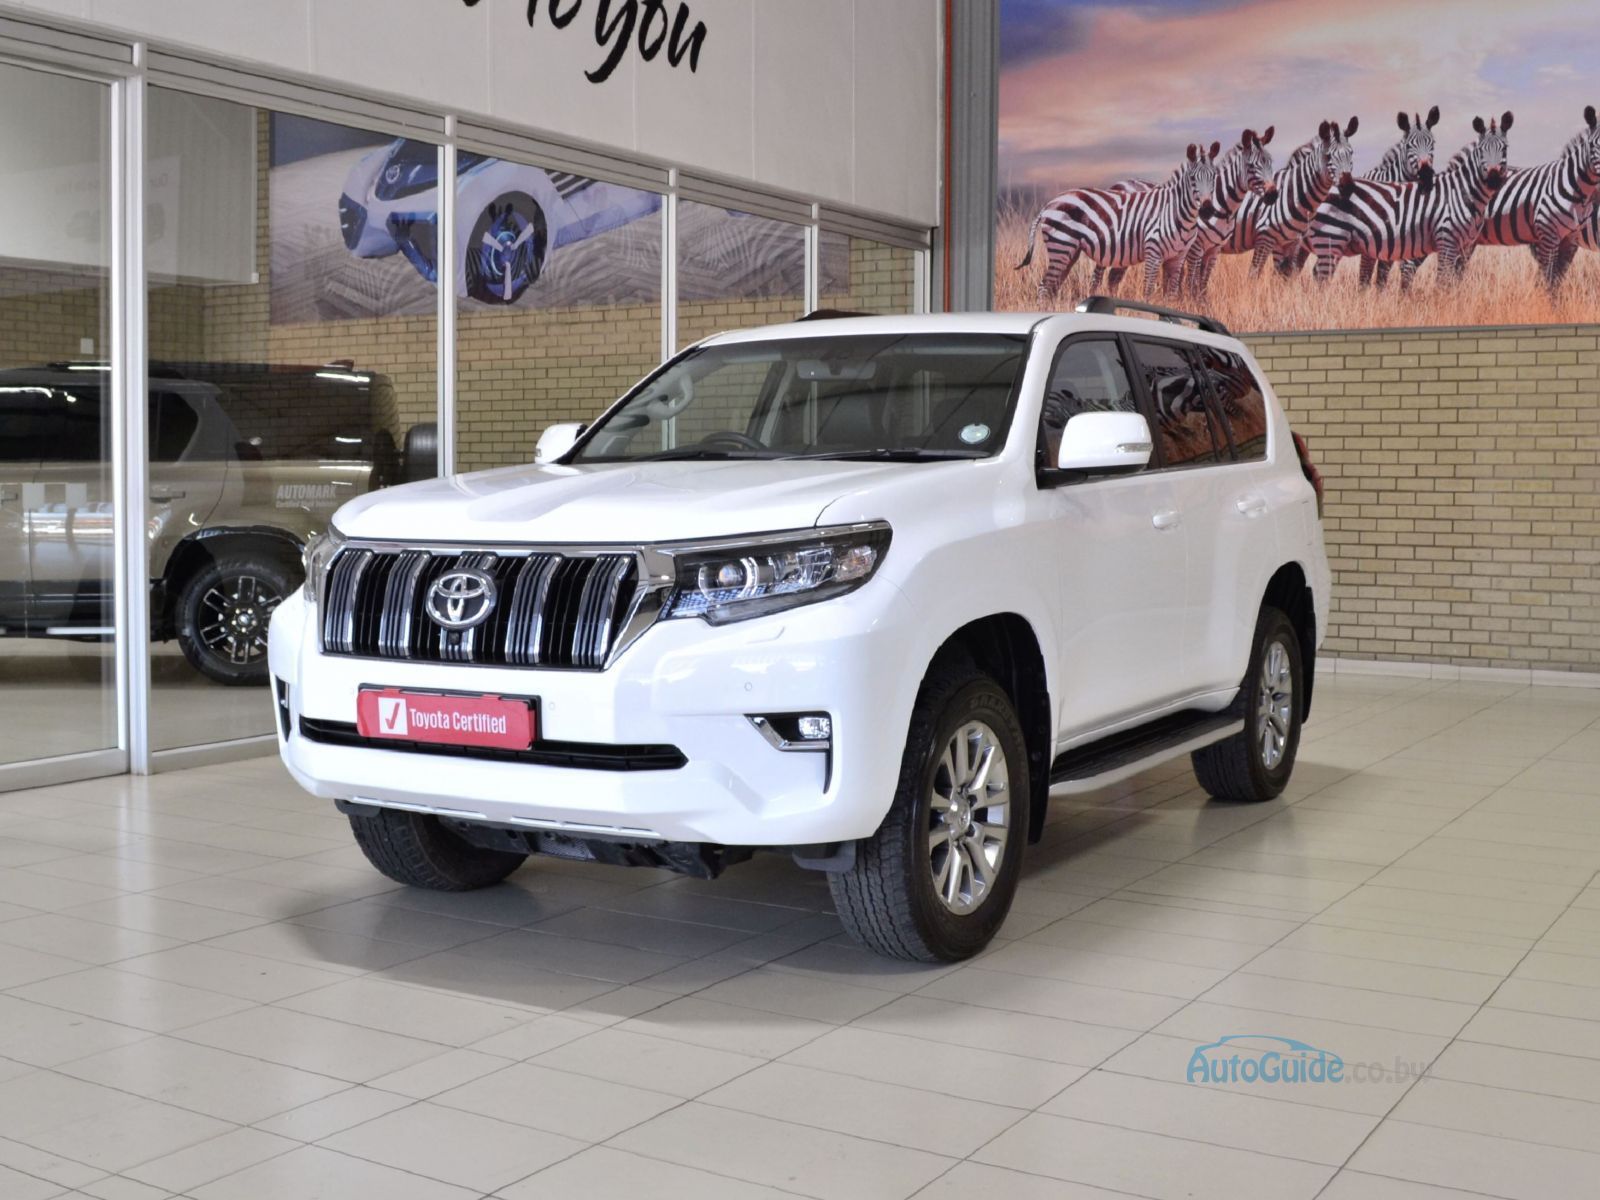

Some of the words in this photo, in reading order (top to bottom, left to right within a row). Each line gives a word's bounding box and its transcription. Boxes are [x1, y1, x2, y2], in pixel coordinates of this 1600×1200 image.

[584, 0, 707, 83] you
[276, 485, 336, 499] AUTOMARK
[410, 709, 450, 729] Toyota
[452, 712, 507, 734] Certified
